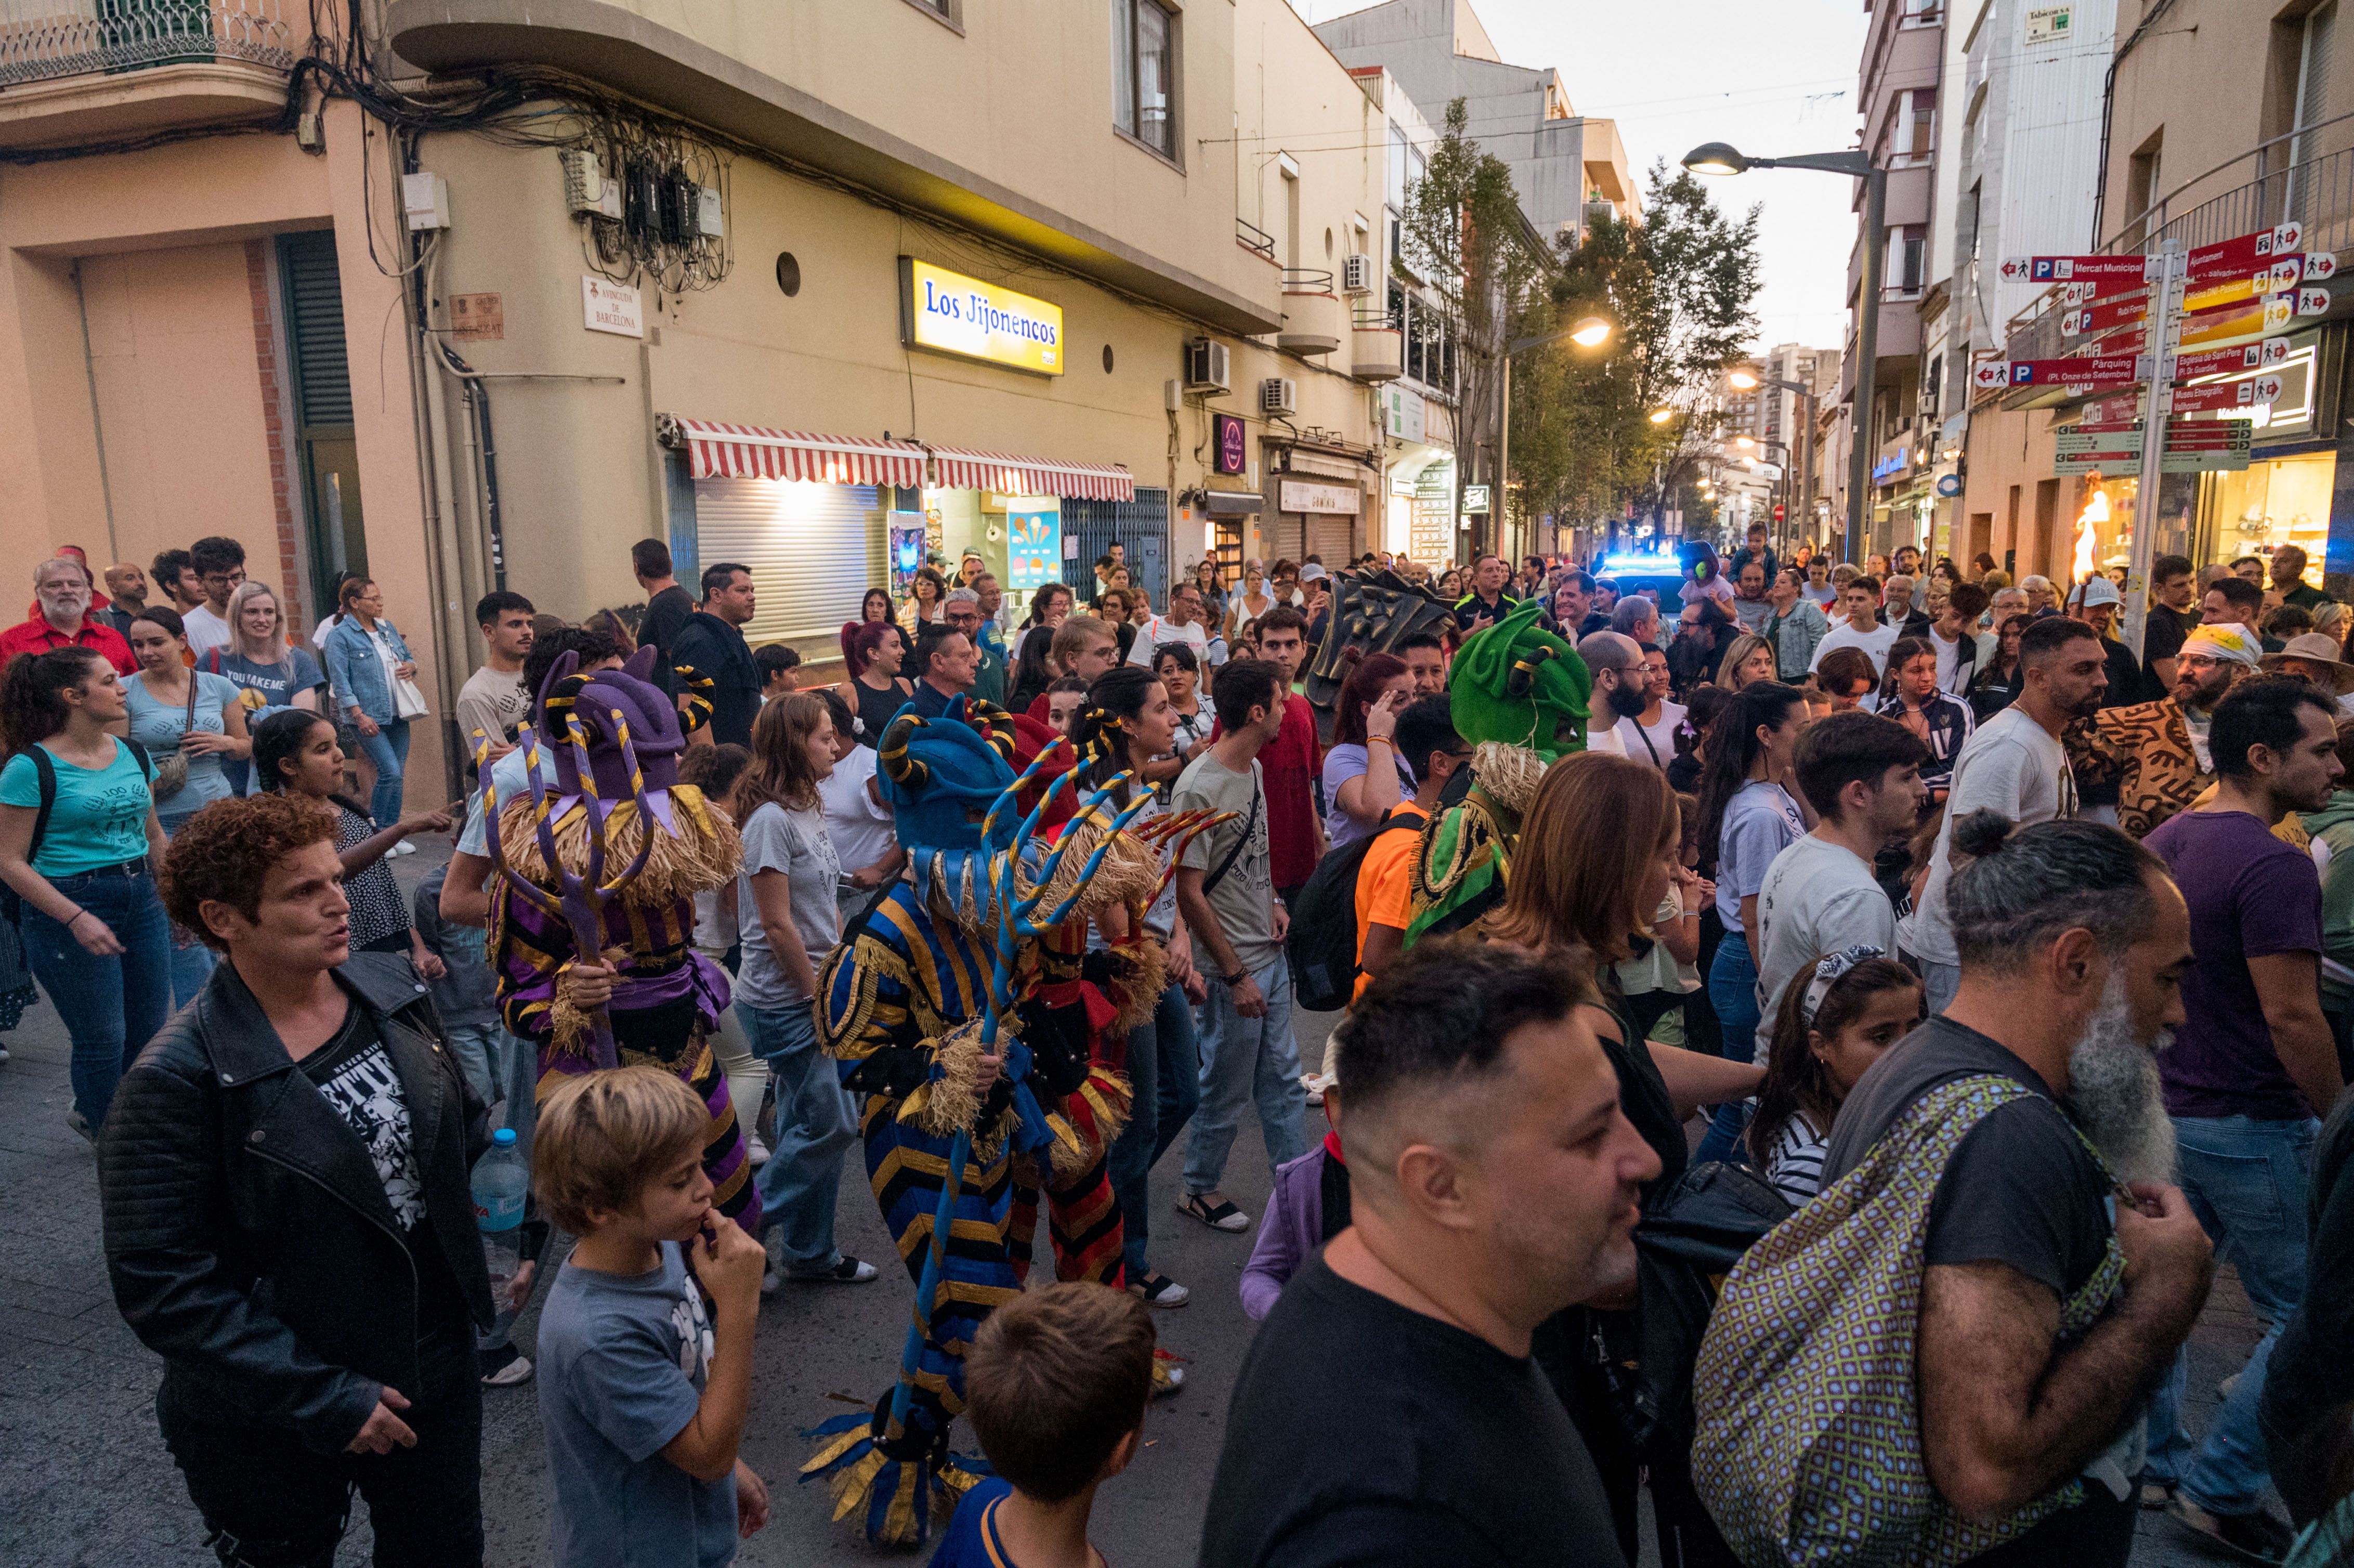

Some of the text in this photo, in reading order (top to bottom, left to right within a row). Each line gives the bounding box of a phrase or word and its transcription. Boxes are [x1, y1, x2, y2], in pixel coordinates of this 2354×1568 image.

[2190, 251, 2224, 267] Ajuntament
[2075, 264, 2102, 272] Mercat
[2104, 263, 2142, 272] Municipal
[603, 289, 633, 304] AVINGUDA
[2187, 291, 2206, 301] Oficina
[612, 303, 620, 313] DE
[926, 281, 1055, 345] Los Jijonencos
[596, 311, 635, 329] BARCELONA
[2189, 325, 2209, 334] Casino
[2179, 355, 2203, 365] Església
[2212, 352, 2227, 361] Sant
[2227, 349, 2241, 358] Pere
[2092, 359, 2131, 369] Pàrquing
[2048, 373, 2060, 382] (Pl.
[2082, 371, 2092, 380] de
[2093, 371, 2131, 380] Setembre)
[2175, 390, 2193, 399] Museu
[227, 669, 245, 683] YOU
[270, 680, 286, 690] ME
[103, 787, 127, 798] 100
[333, 1054, 364, 1074] NEVER
